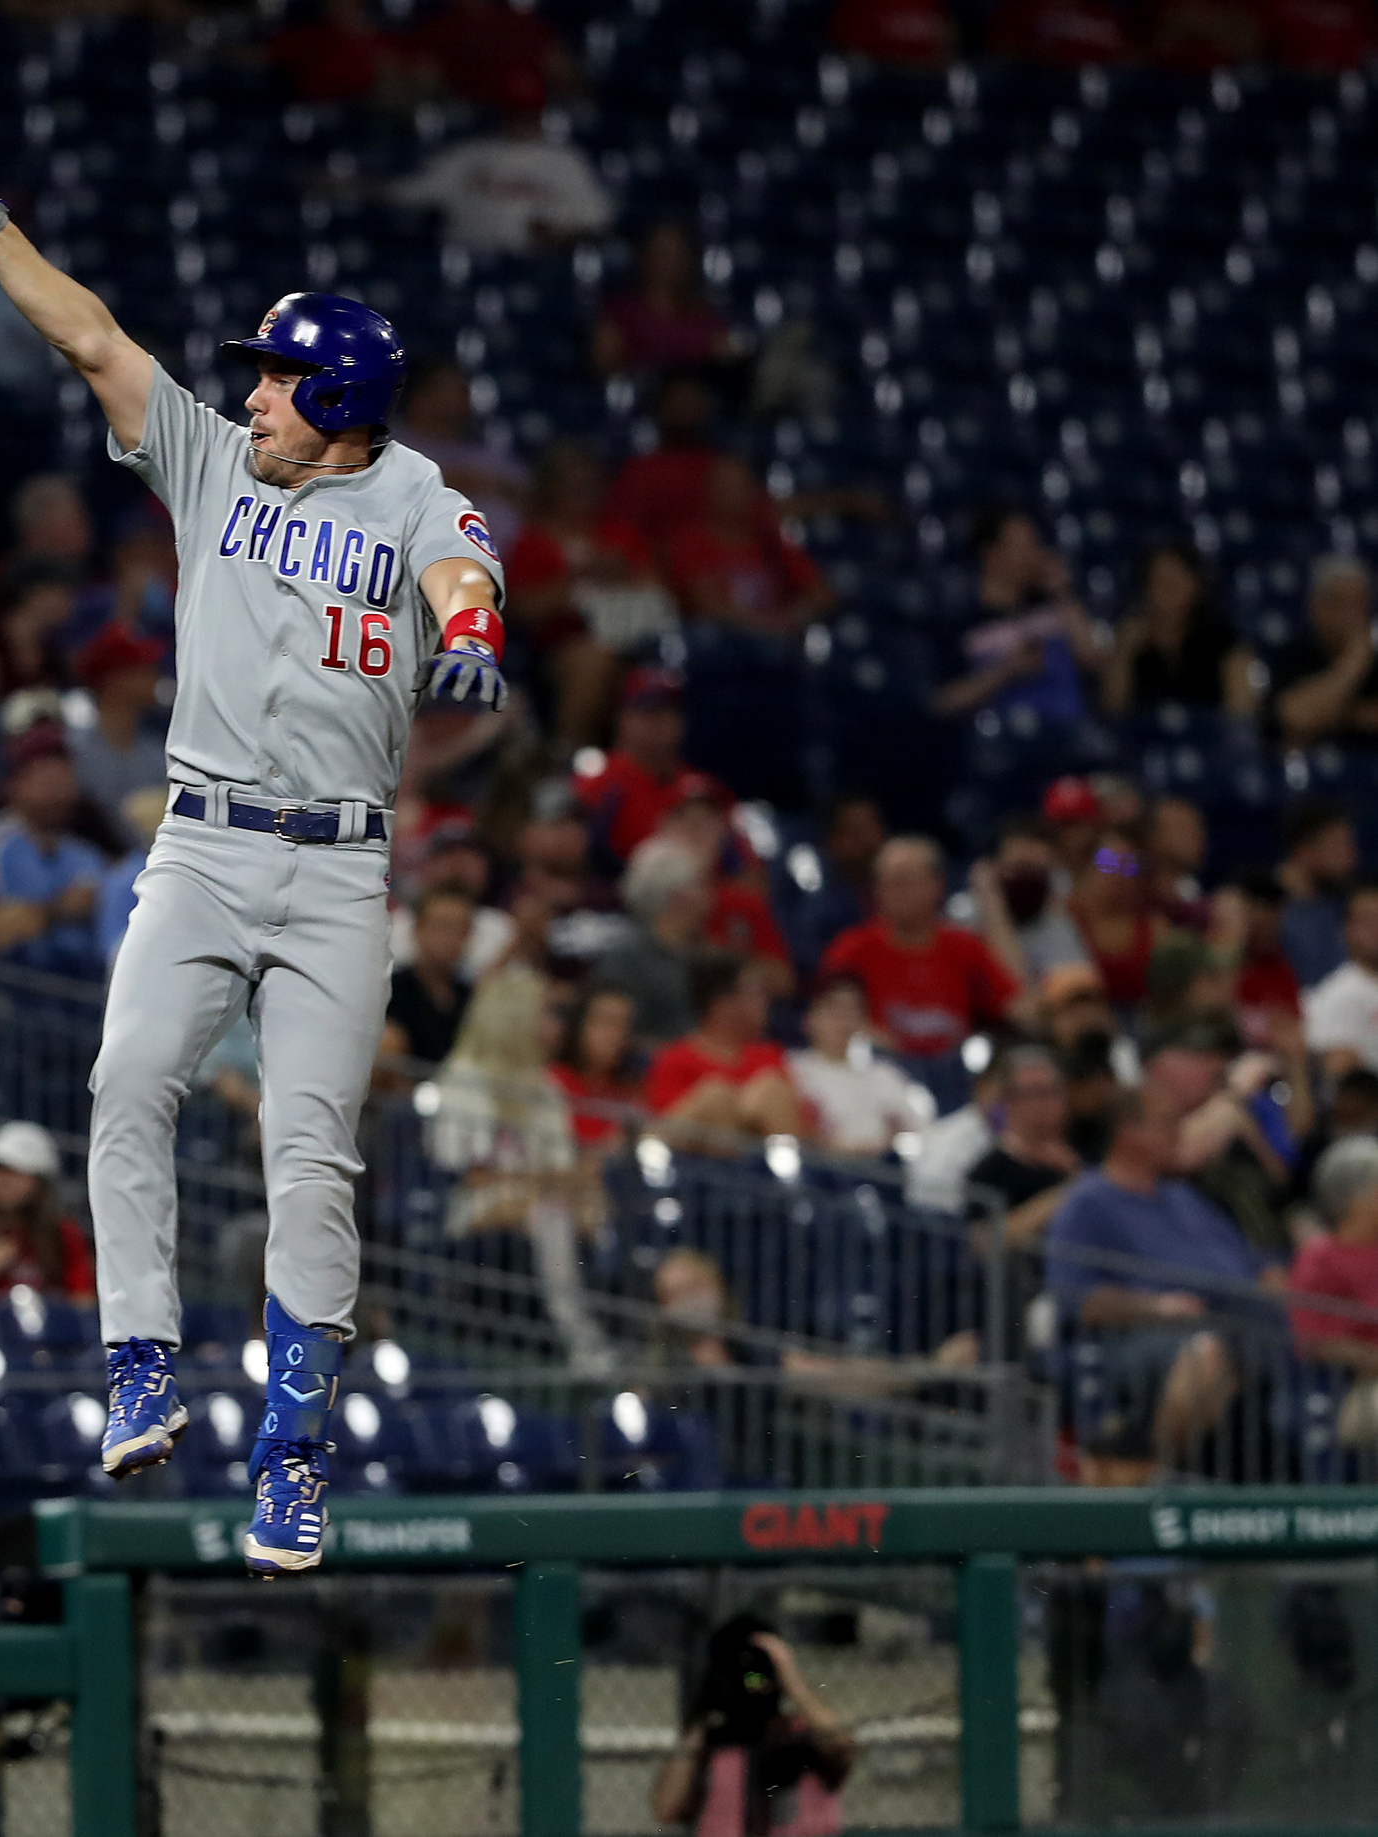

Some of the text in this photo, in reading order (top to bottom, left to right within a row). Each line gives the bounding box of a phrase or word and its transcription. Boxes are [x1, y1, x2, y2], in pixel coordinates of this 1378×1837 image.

[219, 494, 396, 609] CHCAGO
[319, 603, 393, 678] 16
[741, 1502, 891, 1551] GIANT
